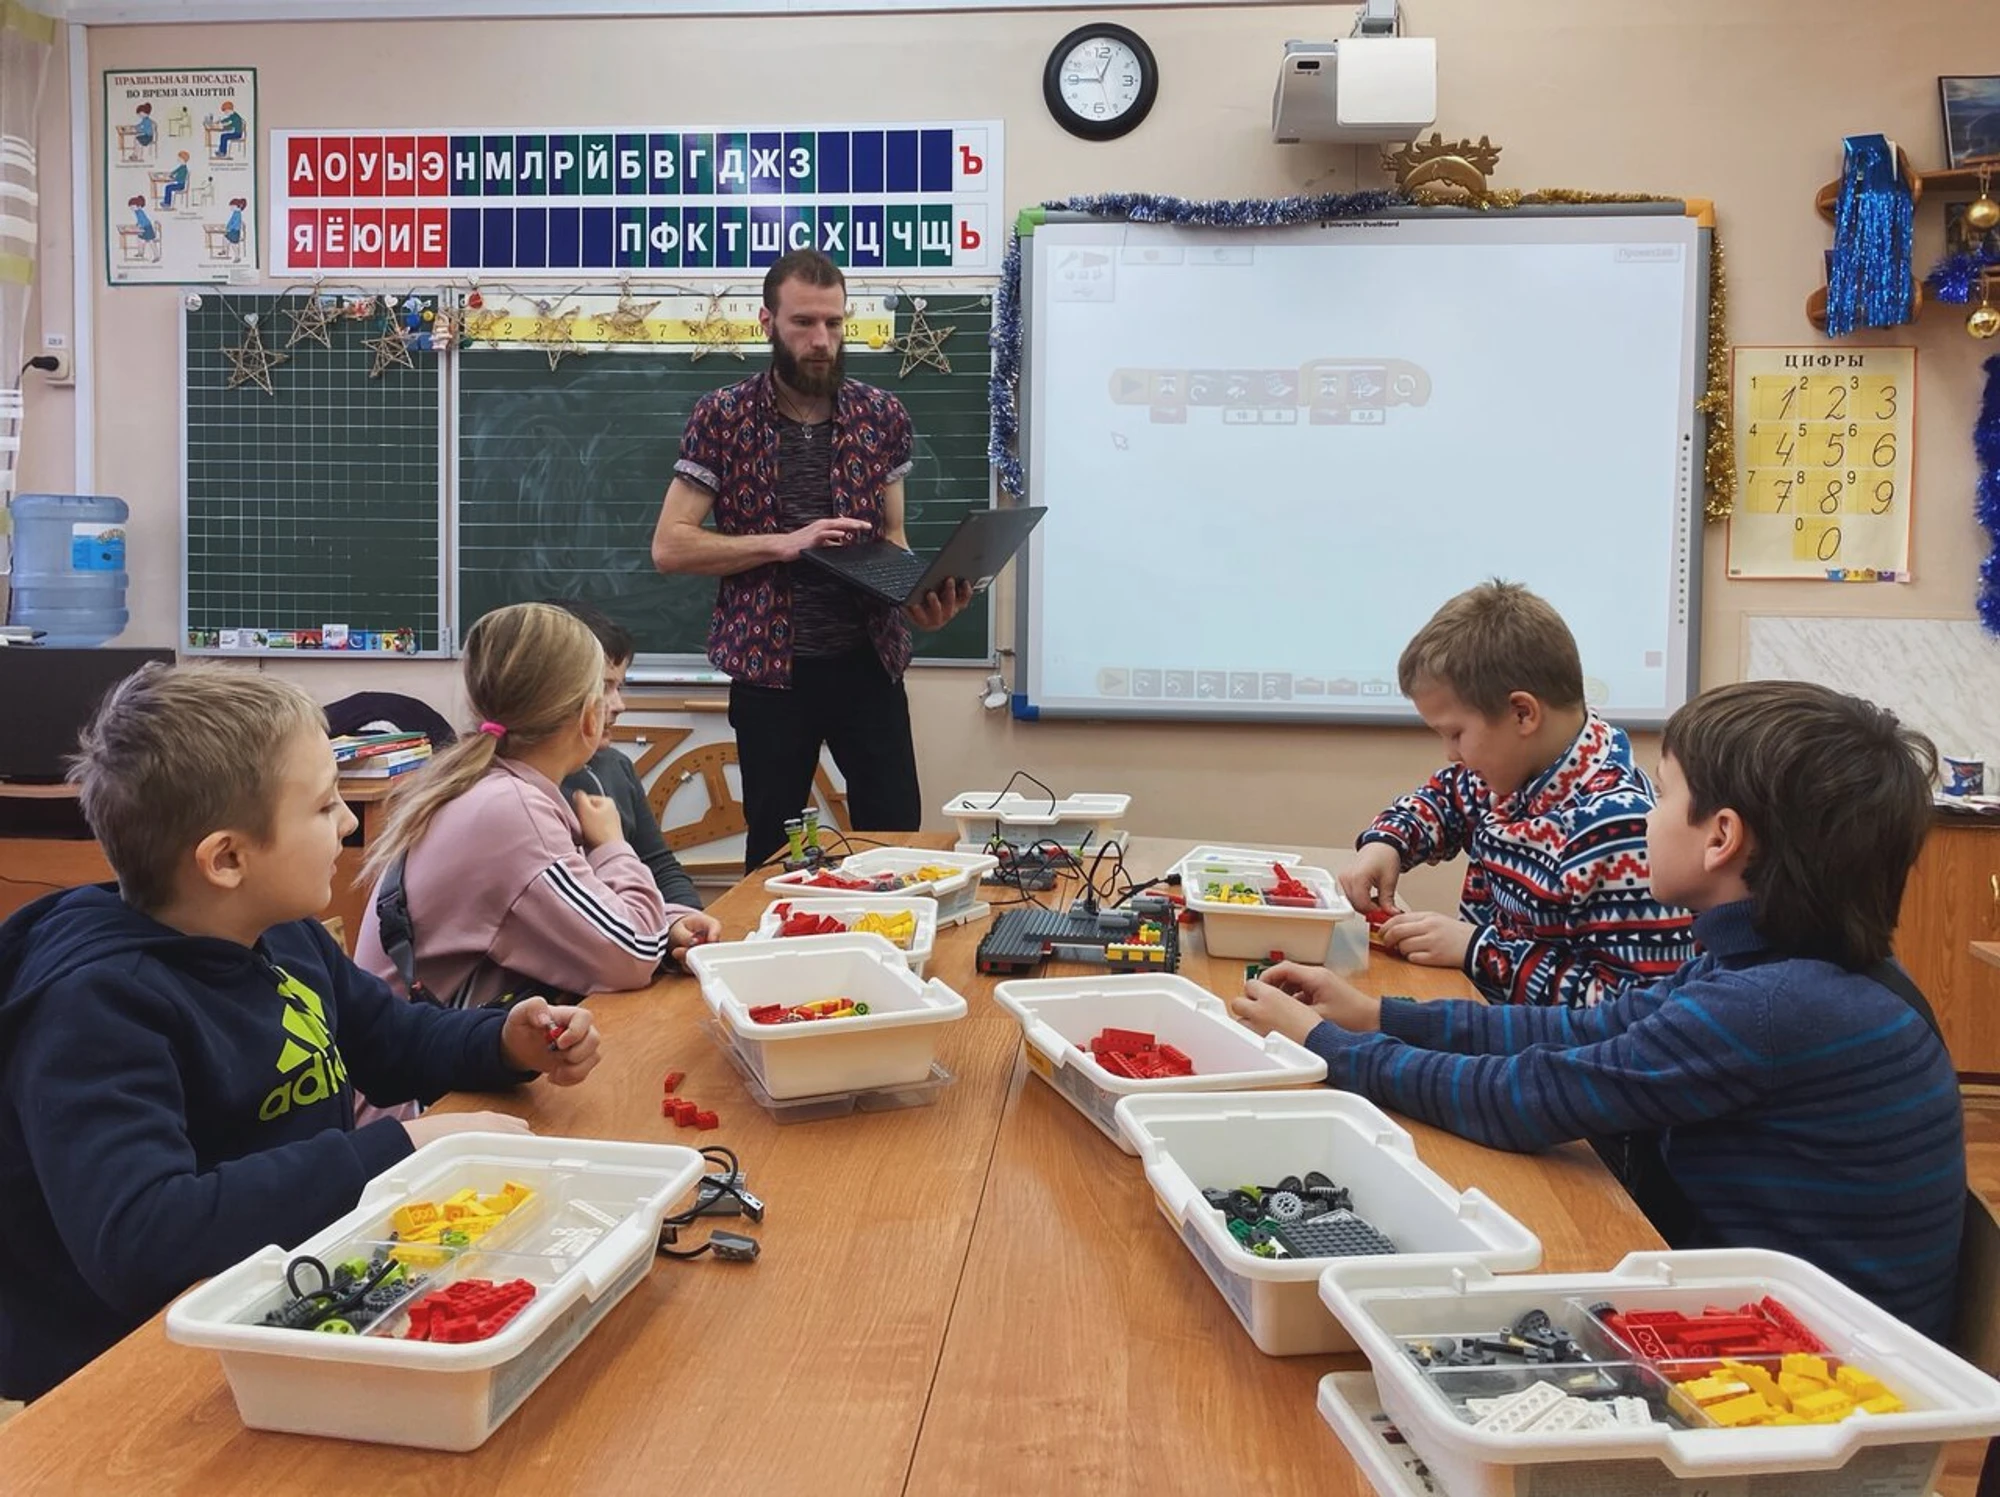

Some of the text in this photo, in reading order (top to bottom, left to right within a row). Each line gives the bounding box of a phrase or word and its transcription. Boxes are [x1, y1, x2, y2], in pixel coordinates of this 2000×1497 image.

[1094, 47, 1111, 58] 12
[114, 74, 246, 86] ПРАВИЛЬНАЯ ПОСАДКА
[1068, 74, 1134, 87] 9 3
[126, 86, 235, 98] ВО ВРЕМЯ ЗАНЯТИЙ
[1094, 103, 1106, 114] 6
[293, 143, 983, 184] А О У Ы Э Н М Л Р Й Б В Г Д Ж З Ъ
[293, 217, 981, 257] Я Ё Ю И Е П Ф К Т Ш С Х Ц Ч Щ Ь
[504, 322, 512, 335] 2
[596, 323, 604, 336] 5
[659, 323, 667, 337] 7
[689, 324, 697, 337] 8
[720, 324, 729, 337] 9
[750, 324, 764, 337] 10
[845, 324, 858, 337] 13
[877, 323, 890, 337] 14
[1785, 355, 1864, 369] ЦИФРЫ
[1751, 377, 1757, 388] 1
[1800, 377, 1808, 389] 2
[1850, 377, 1859, 389] 3
[1779, 386, 1796, 420] 1
[1825, 386, 1847, 420] 2
[1875, 386, 1897, 420] 3
[1749, 424, 1757, 436] 4
[1798, 424, 1807, 437] 5
[1849, 424, 1857, 437] 6
[1776, 433, 1795, 467] 4
[1823, 433, 1844, 467] 5
[1872, 433, 1897, 467] 6
[1748, 471, 1756, 483] 7
[1797, 471, 1805, 484] 8
[1847, 471, 1856, 484] 9
[1774, 480, 1793, 513] 7
[1820, 480, 1843, 514] 8
[1871, 480, 1894, 515] 9
[1795, 517, 1803, 530] 0
[1817, 527, 1842, 561] 0
